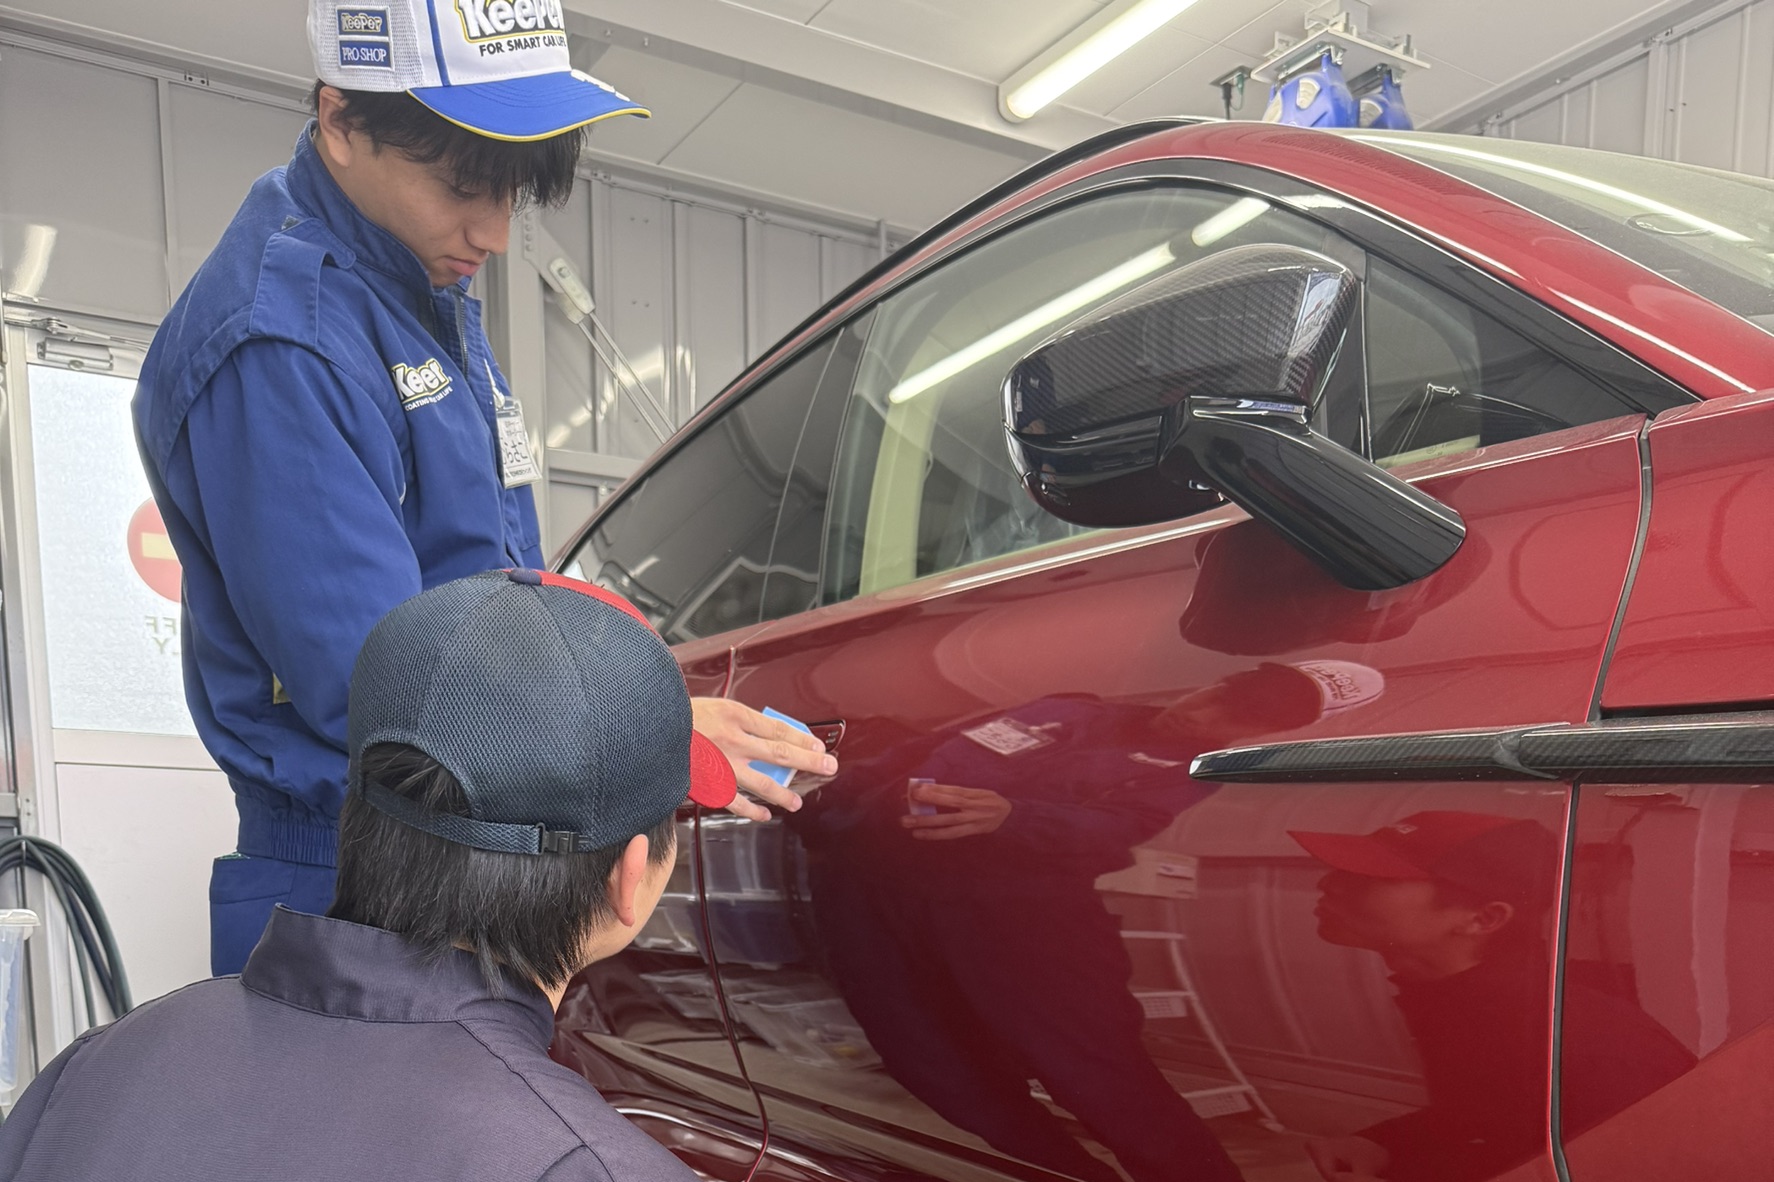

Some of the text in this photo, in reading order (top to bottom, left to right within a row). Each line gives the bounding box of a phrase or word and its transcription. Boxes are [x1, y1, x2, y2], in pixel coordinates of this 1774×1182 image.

[360, 47, 387, 62] SHOP
[479, 42, 505, 57] FOR
[507, 36, 540, 52] SMART
